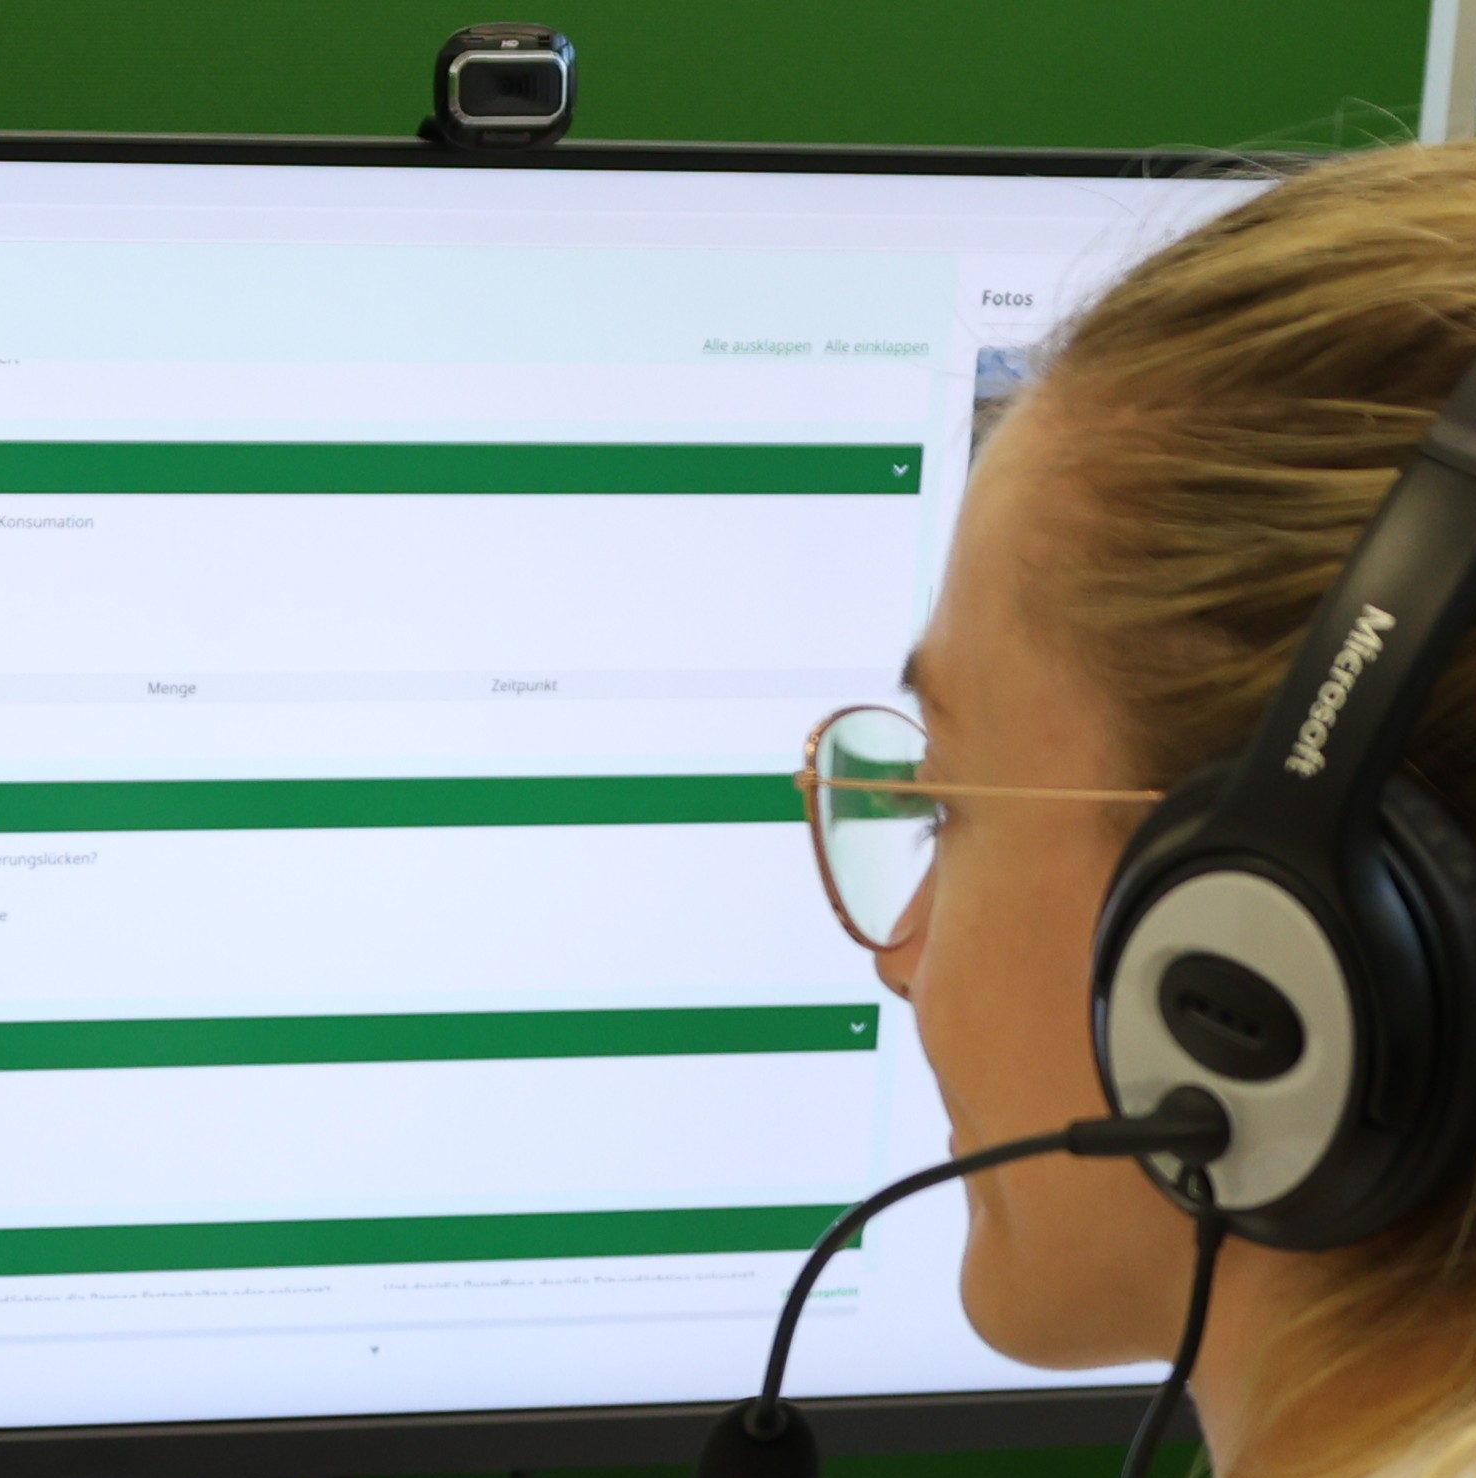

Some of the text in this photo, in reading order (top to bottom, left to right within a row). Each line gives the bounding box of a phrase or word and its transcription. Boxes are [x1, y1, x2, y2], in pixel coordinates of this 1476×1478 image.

[981, 289, 1034, 307] Fotos
[702, 339, 812, 353] Alle ausklappen
[823, 339, 929, 353] Alle einklappen
[147, 681, 197, 699] Menge
[491, 678, 558, 696] Zeitpunkt
[1284, 603, 1396, 780] Microsoft
